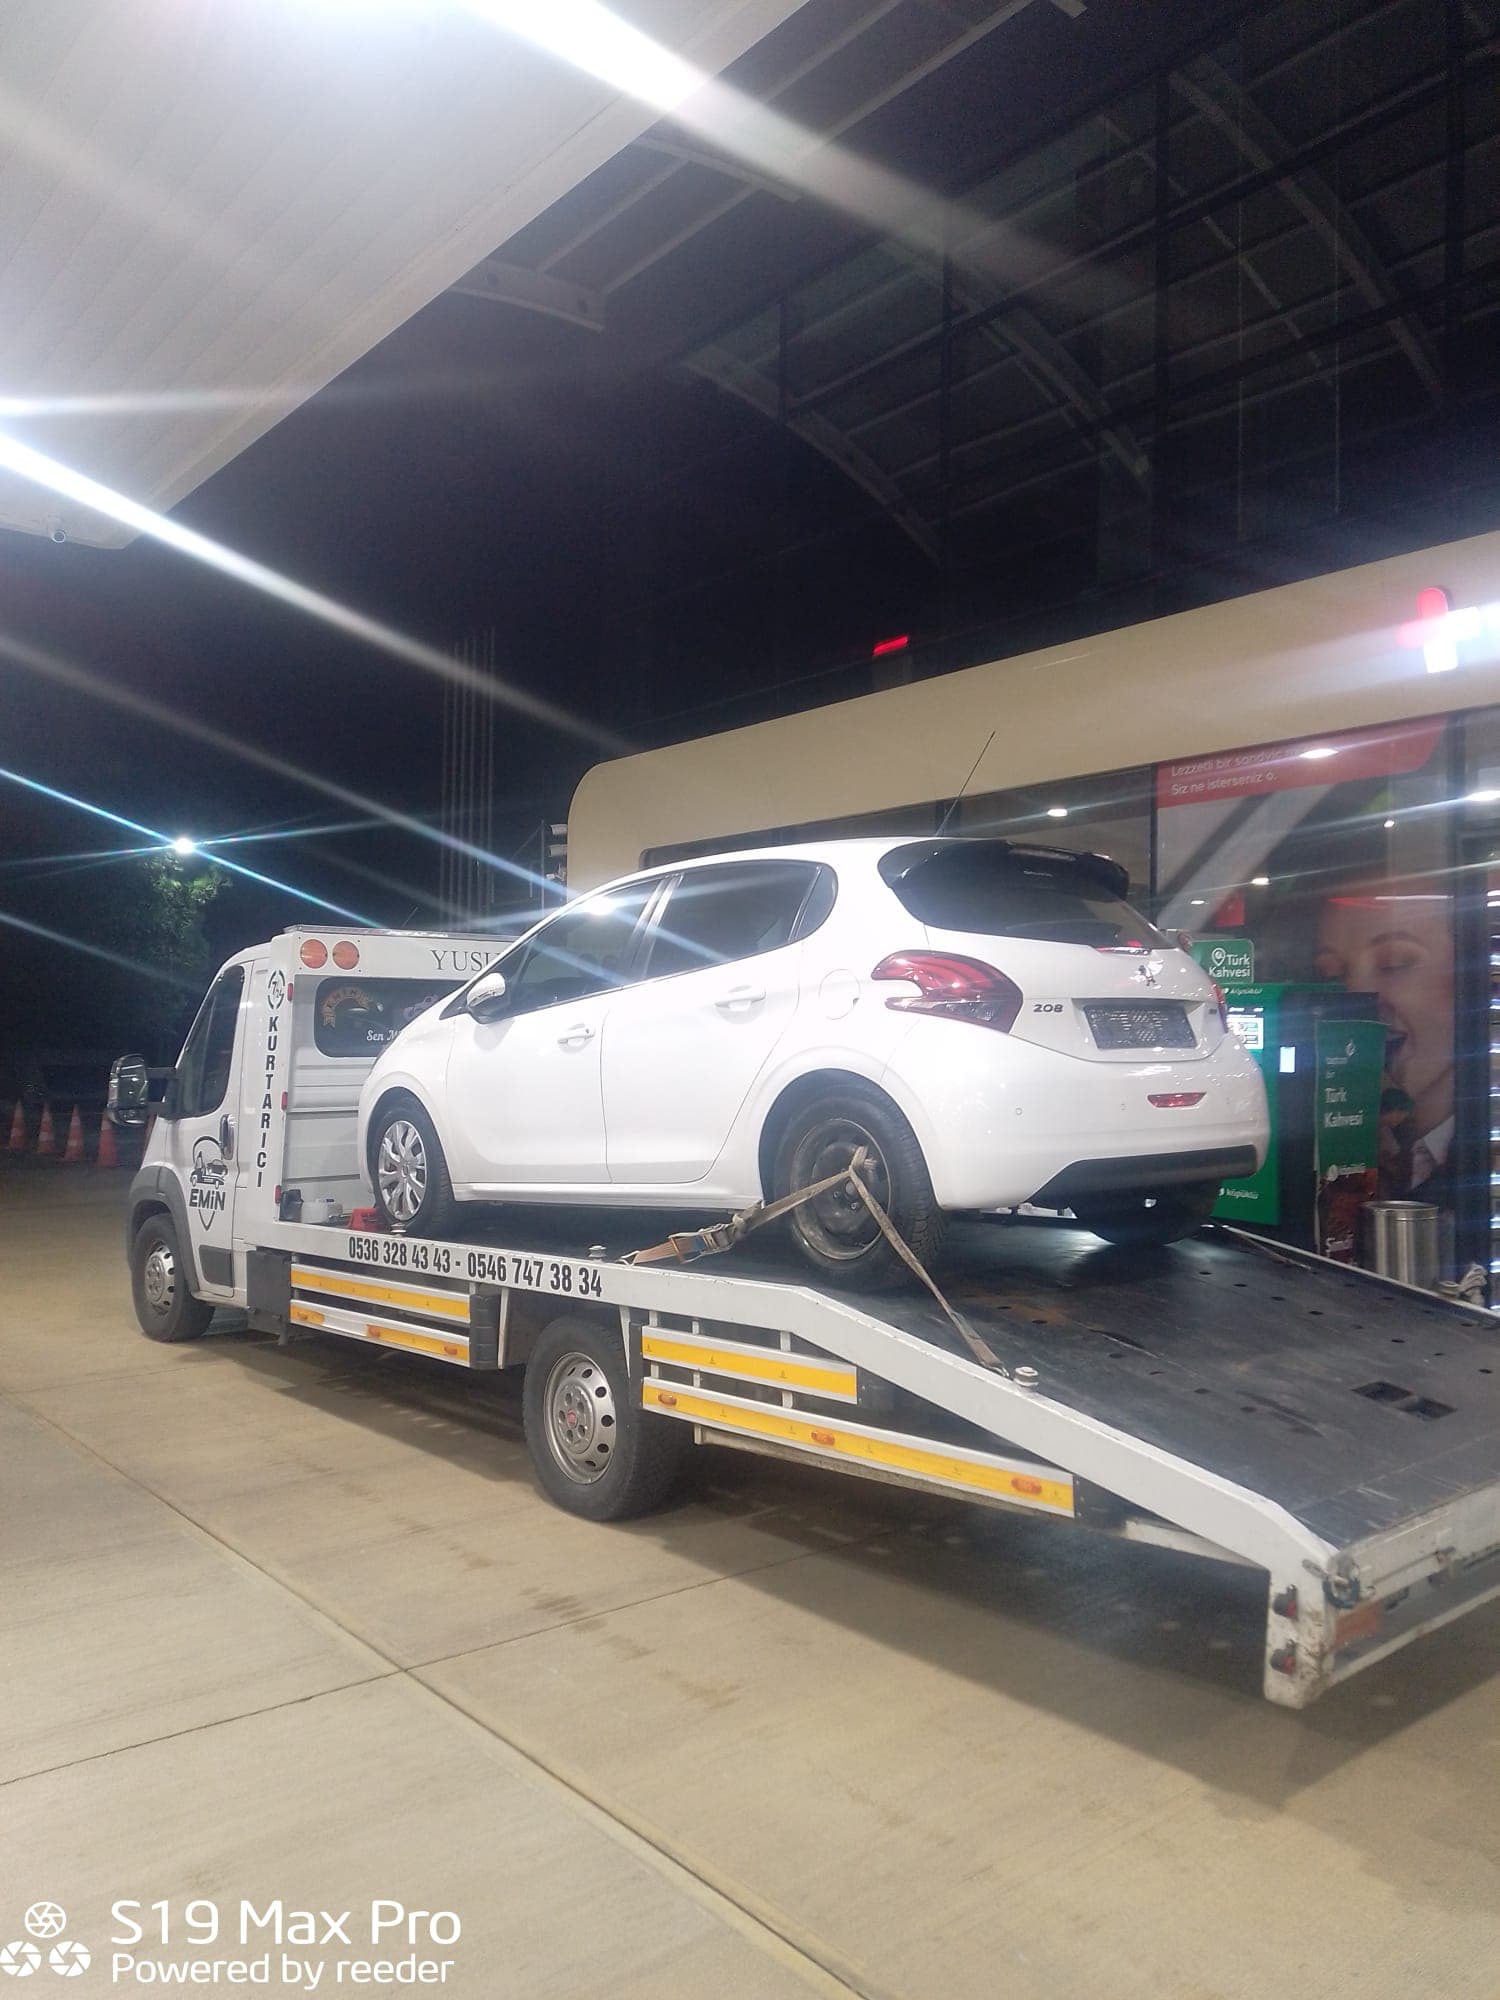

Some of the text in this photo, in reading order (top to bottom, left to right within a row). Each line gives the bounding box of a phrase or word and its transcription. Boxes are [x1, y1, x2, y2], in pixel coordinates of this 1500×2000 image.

[1226, 953, 1250, 966] Türk
[1208, 965, 1250, 978] Kahvesi
[1033, 1003, 1063, 1013] 208
[366, 1029, 384, 1041] Sen
[256, 1016, 279, 1188] KURTARICI
[1324, 1110, 1364, 1128] Kahvesi
[348, 1236, 379, 1262] 0536
[383, 1241, 407, 1267] 328
[412, 1244, 428, 1270] 43
[433, 1247, 451, 1273] 43
[467, 1252, 507, 1282] 0546
[512, 1257, 544, 1287] 747
[550, 1262, 572, 1292] 38
[579, 1267, 602, 1297] 34
